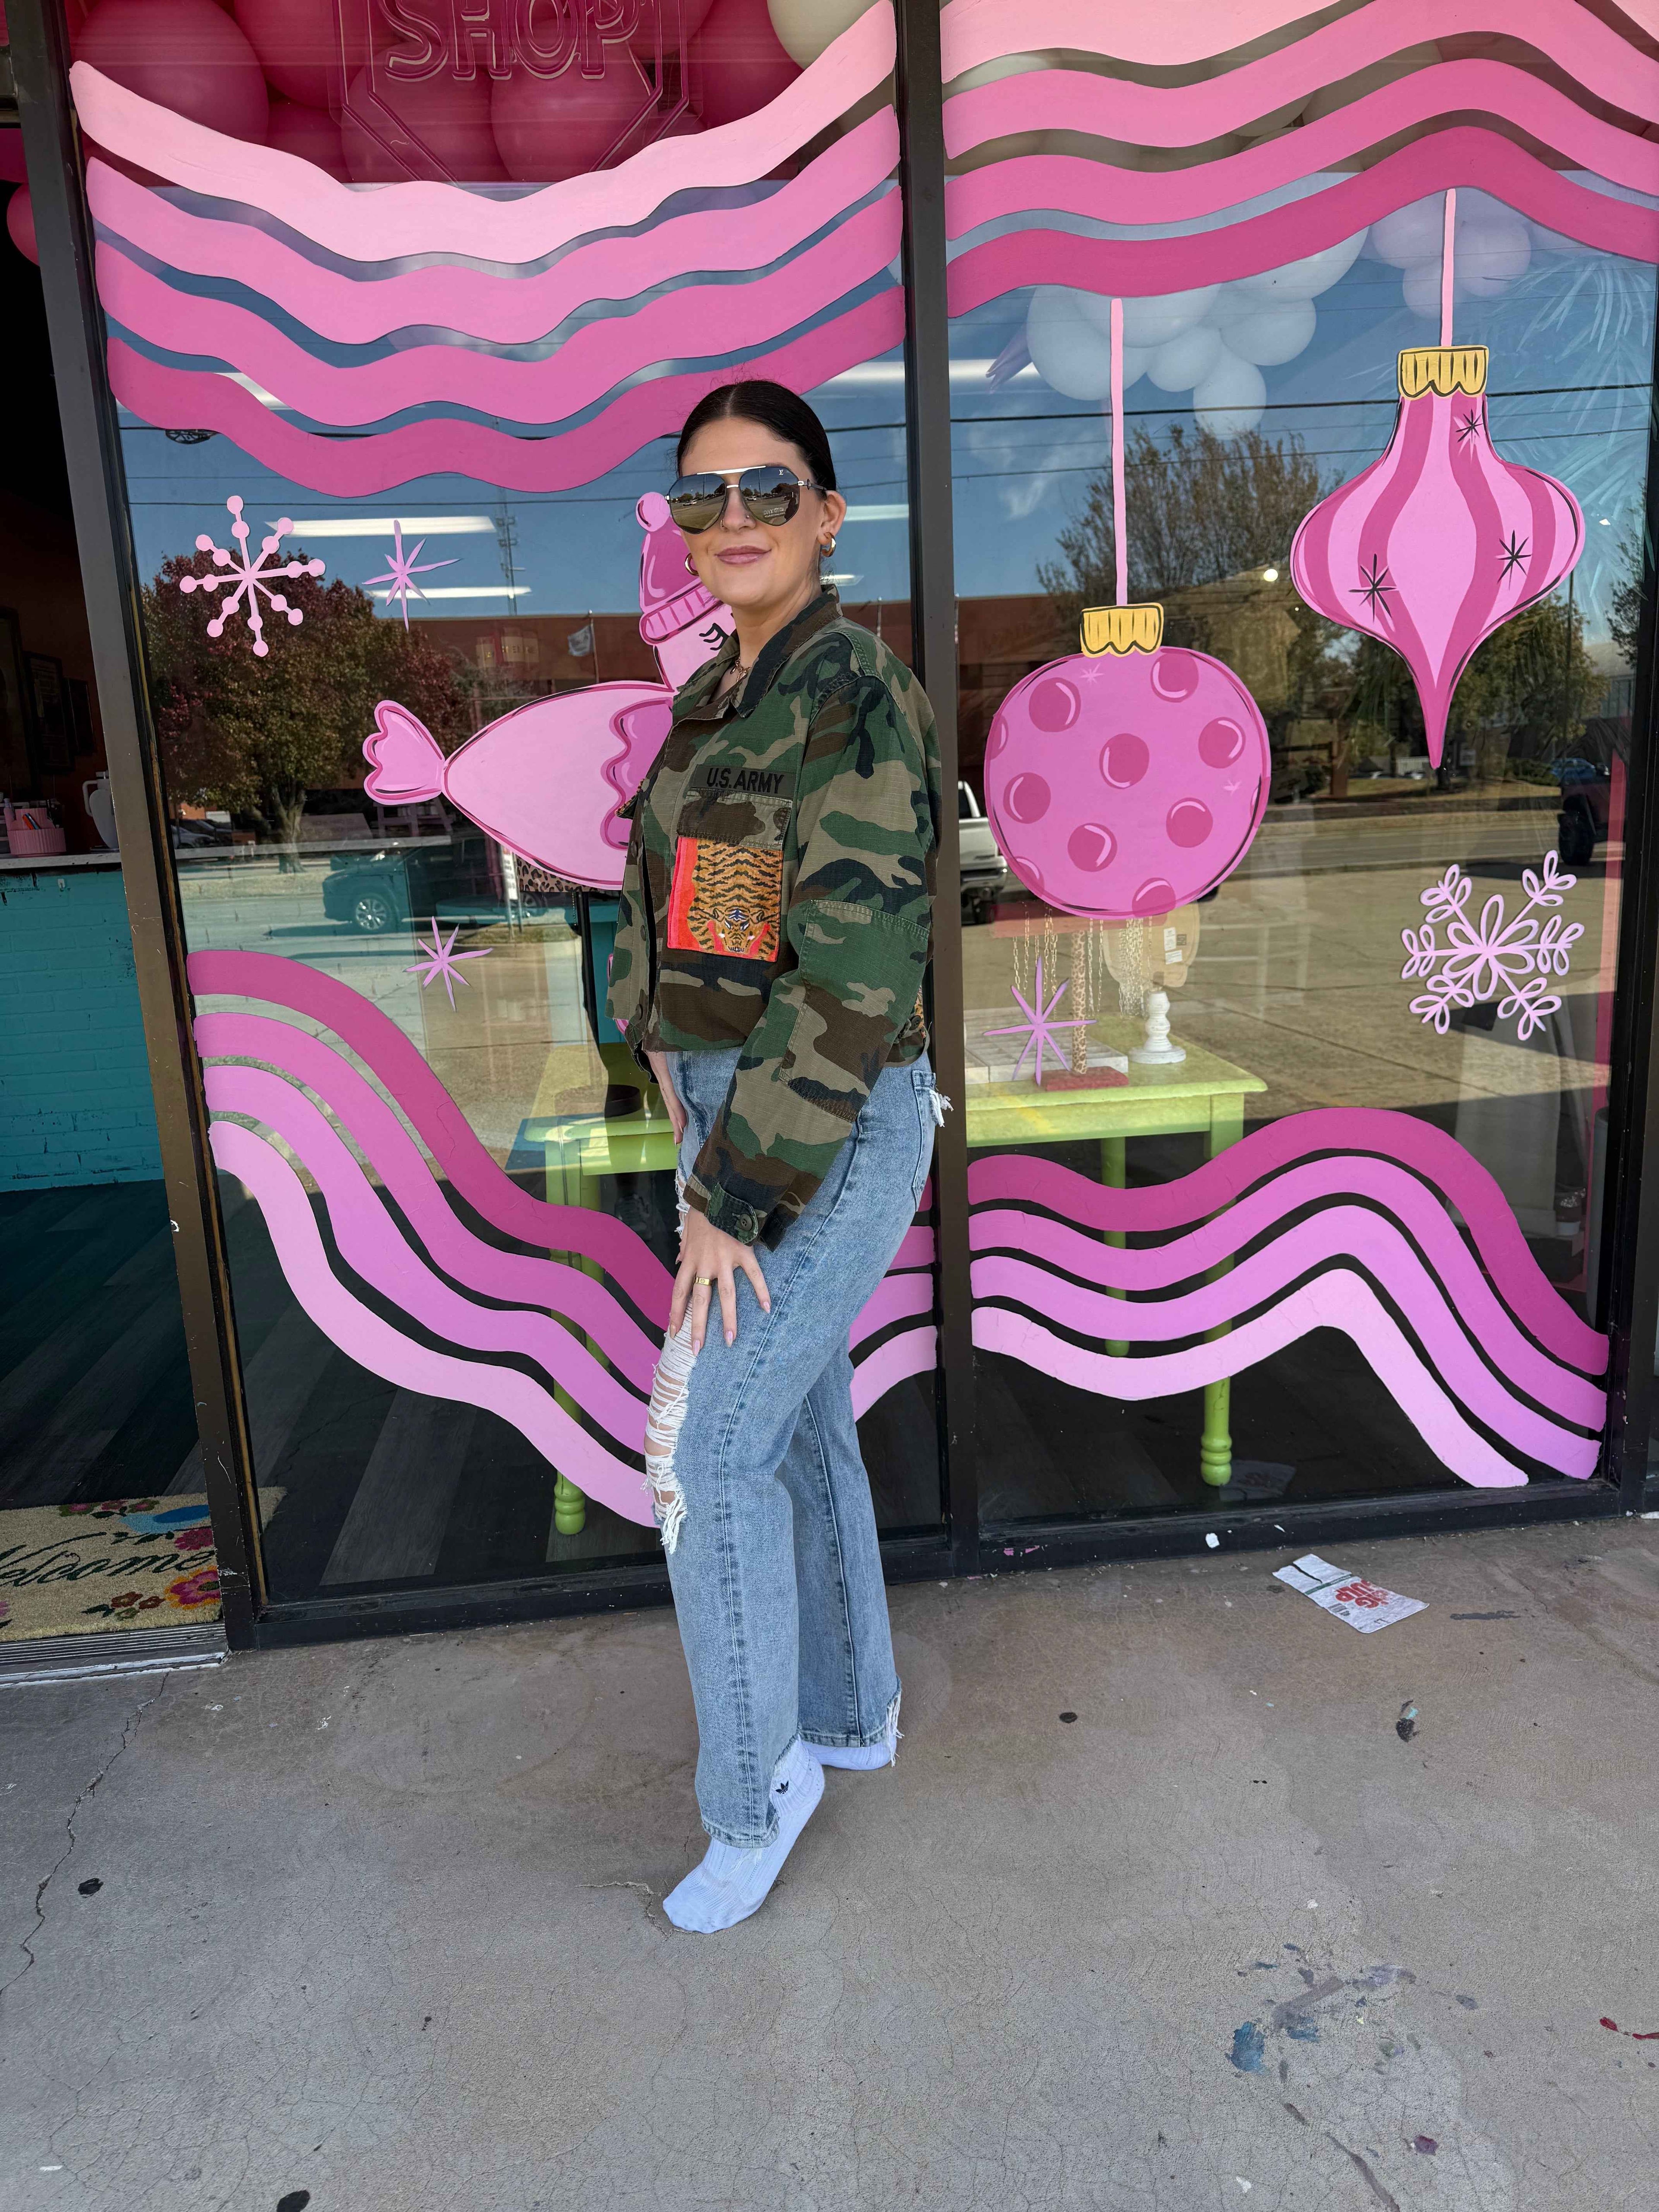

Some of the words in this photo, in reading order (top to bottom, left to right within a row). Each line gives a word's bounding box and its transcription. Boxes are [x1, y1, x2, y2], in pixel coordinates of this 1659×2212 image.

[379, 0, 640, 80] SHOP
[707, 768, 731, 788] U.S.
[734, 770, 785, 794] ARMY
[0, 1532, 216, 1587] elcome
